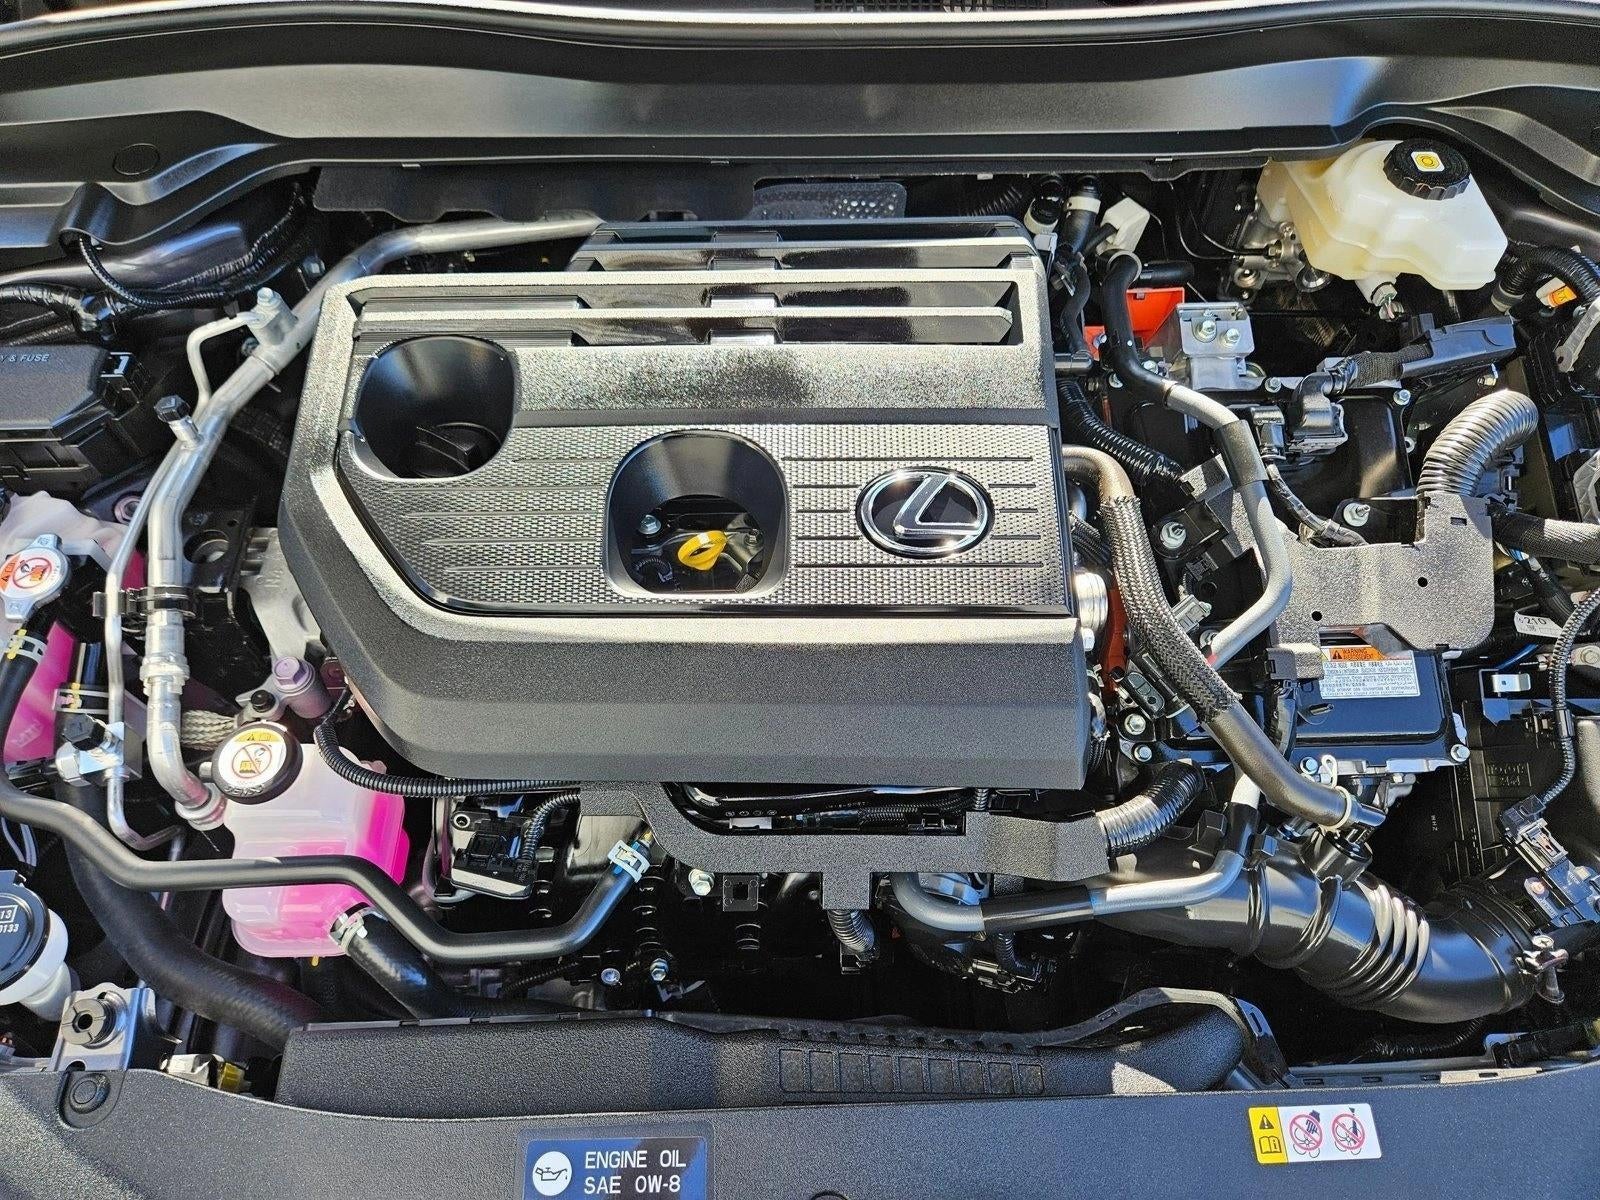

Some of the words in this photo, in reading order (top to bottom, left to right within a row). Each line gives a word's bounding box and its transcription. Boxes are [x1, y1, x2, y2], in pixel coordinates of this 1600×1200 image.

[9, 354, 17, 362] &
[20, 353, 50, 362] FUSE
[585, 1150, 648, 1169] ENGINE
[660, 1149, 687, 1168] OIL
[584, 1175, 622, 1194] SAE
